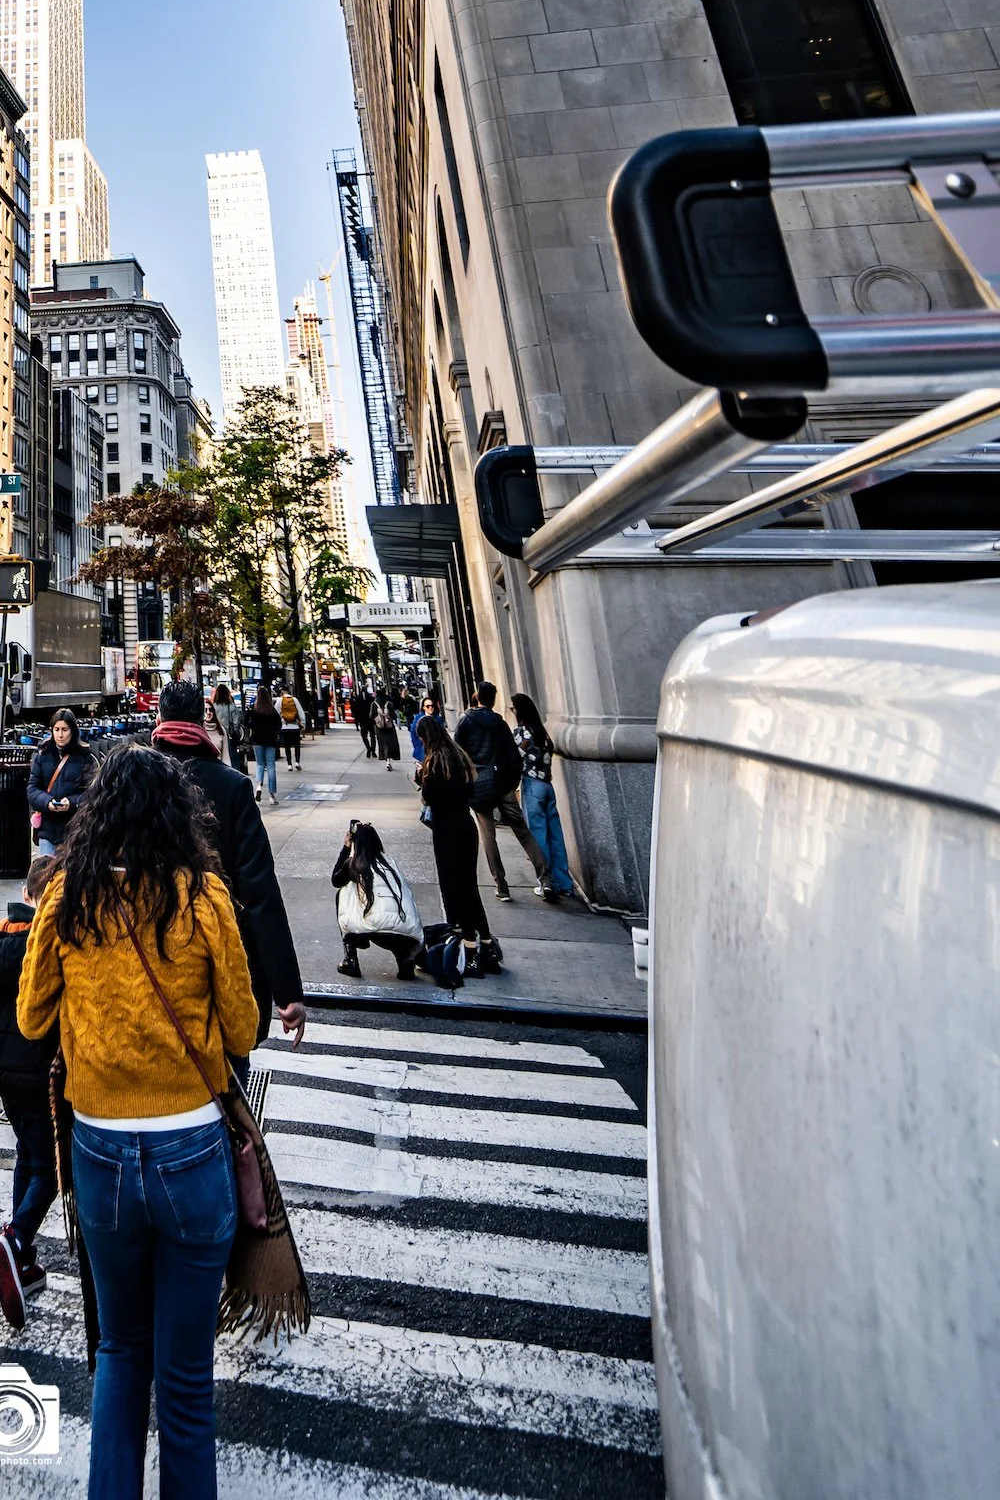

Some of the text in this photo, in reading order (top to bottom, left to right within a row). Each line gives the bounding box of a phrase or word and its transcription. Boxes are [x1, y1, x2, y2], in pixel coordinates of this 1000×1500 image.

[8, 476, 16, 485] ST
[369, 607, 391, 615] BREAD
[400, 607, 428, 615] BUTTER
